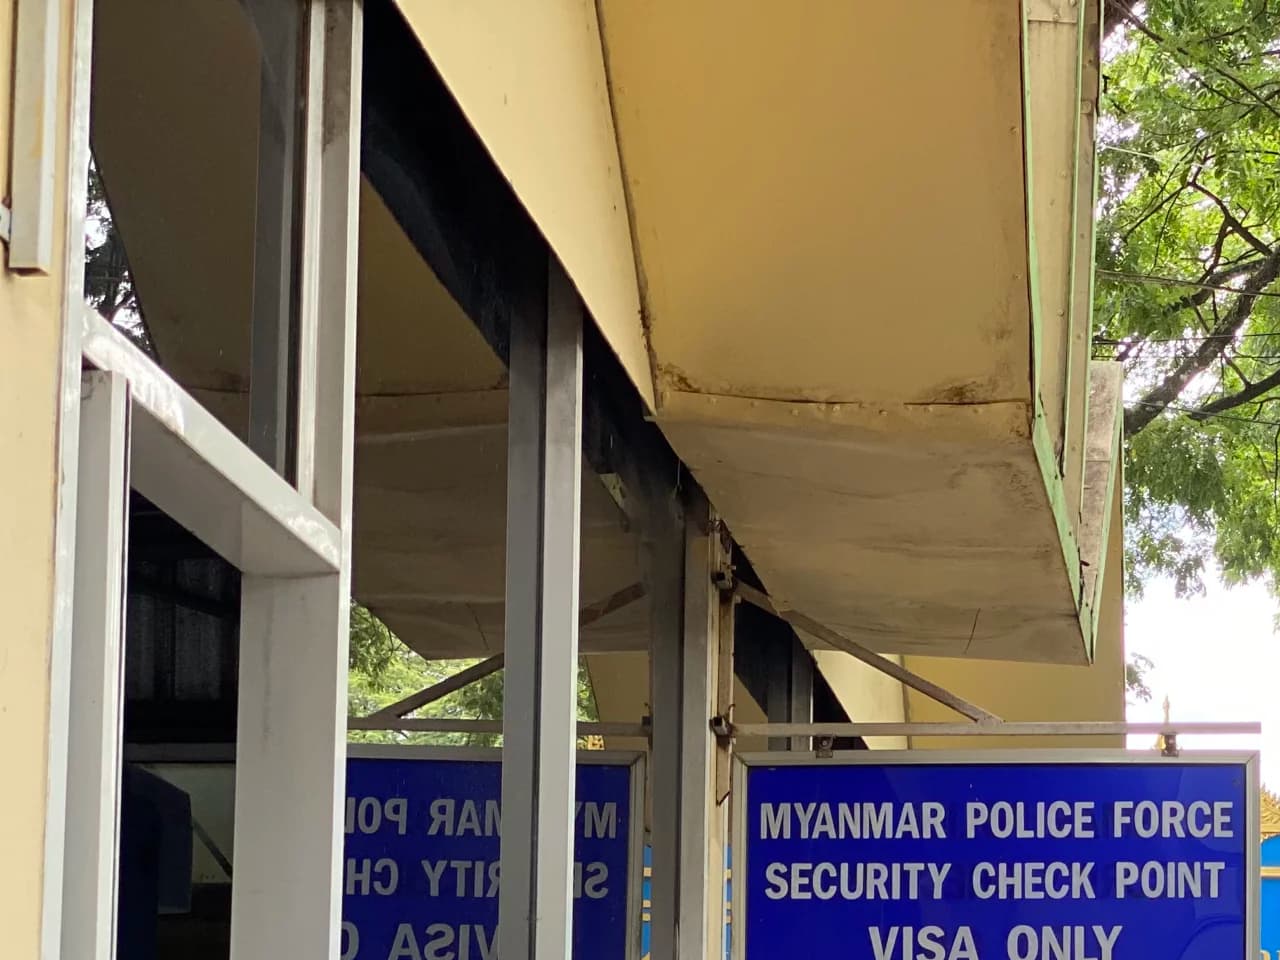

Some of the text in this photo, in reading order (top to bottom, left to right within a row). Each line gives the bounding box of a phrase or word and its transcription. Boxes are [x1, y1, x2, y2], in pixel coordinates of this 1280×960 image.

[760, 800, 1234, 840] MYANMAR POLICE FORCE
[765, 860, 1226, 900] SECURITY CHECK POINT
